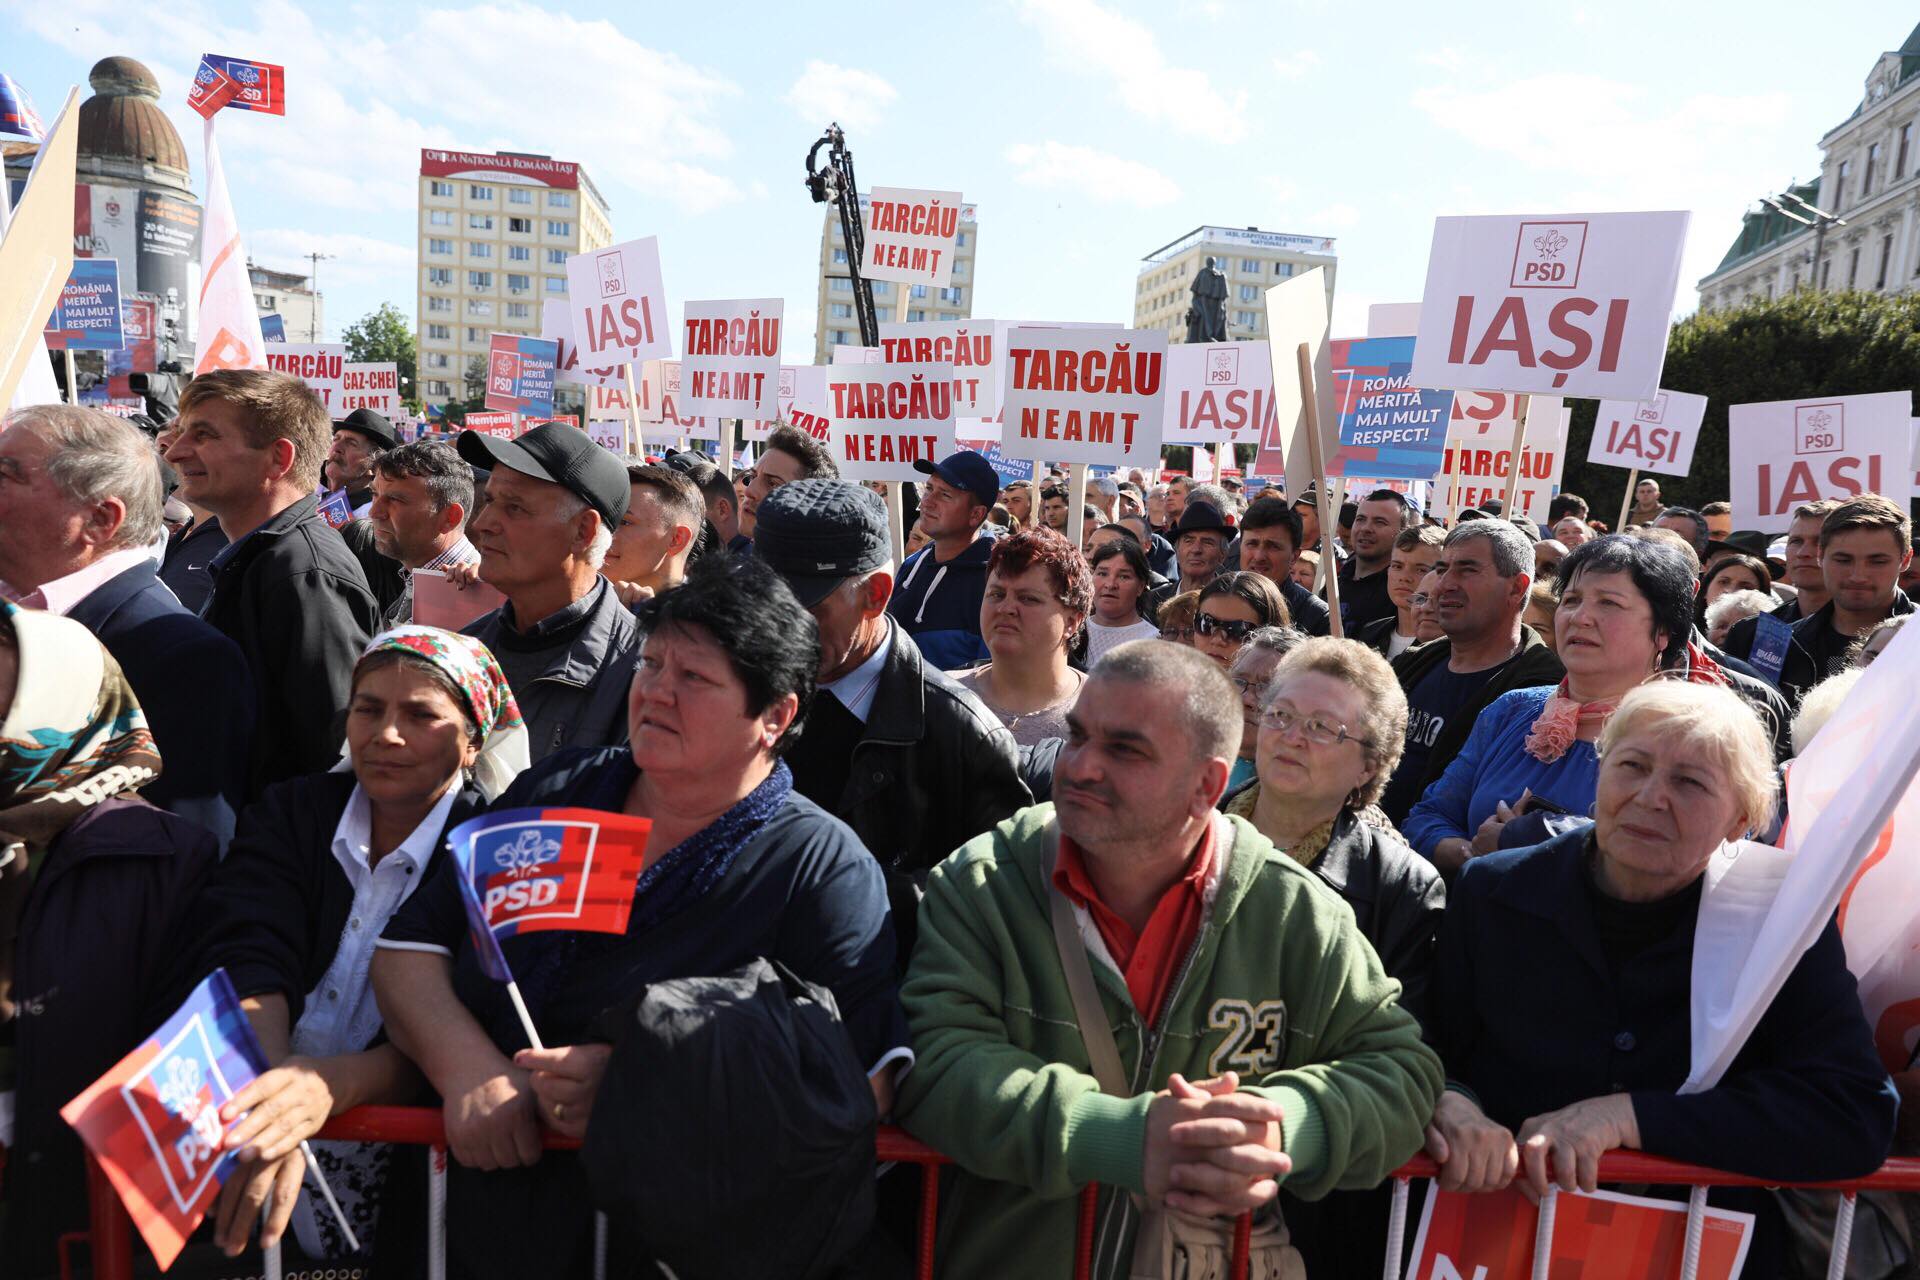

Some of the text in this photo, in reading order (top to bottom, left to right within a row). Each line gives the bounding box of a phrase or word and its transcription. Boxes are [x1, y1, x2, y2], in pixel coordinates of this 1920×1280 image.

[871, 200, 958, 238] TARCĂU
[873, 243, 942, 279] NEAMȚ
[1524, 262, 1566, 282] PSD
[64, 283, 113, 295] ROMÂNIA
[604, 279, 620, 293] PSD
[64, 295, 102, 306] MERITĂ
[65, 307, 115, 318] MAI MULT
[66, 318, 112, 329] RESPECT!
[584, 296, 654, 358] IAȘI
[686, 311, 779, 357] TARCĂU
[1448, 295, 1629, 388] IAȘI
[881, 329, 992, 366] TARCĂU
[523, 359, 553, 369] ROMÂNIA
[1010, 343, 1162, 396] TARCĂU
[343, 371, 396, 391] CAZ-CHEI
[494, 377, 512, 392] PSD
[522, 380, 553, 389] MAI MULT
[1211, 371, 1231, 382] PSD
[520, 389, 549, 399] RESPECT!
[692, 370, 765, 410] NEAMȚ
[829, 374, 950, 420] TARCĂU
[1359, 389, 1422, 410] MERITĂ
[467, 414, 511, 427] Nemțenii
[1179, 389, 1263, 440] IAȘI
[1356, 409, 1441, 427] MAI MULT
[1640, 409, 1658, 420] PSD
[1020, 407, 1139, 454] NEAMȚ
[1352, 428, 1430, 445] RESPECT!
[1606, 420, 1681, 468] IAȘI
[1805, 434, 1833, 449] PSD
[1006, 459, 1032, 470] MULT
[485, 877, 558, 924] PSD
[1209, 998, 1286, 1077] 23
[176, 1104, 224, 1180] PSD
